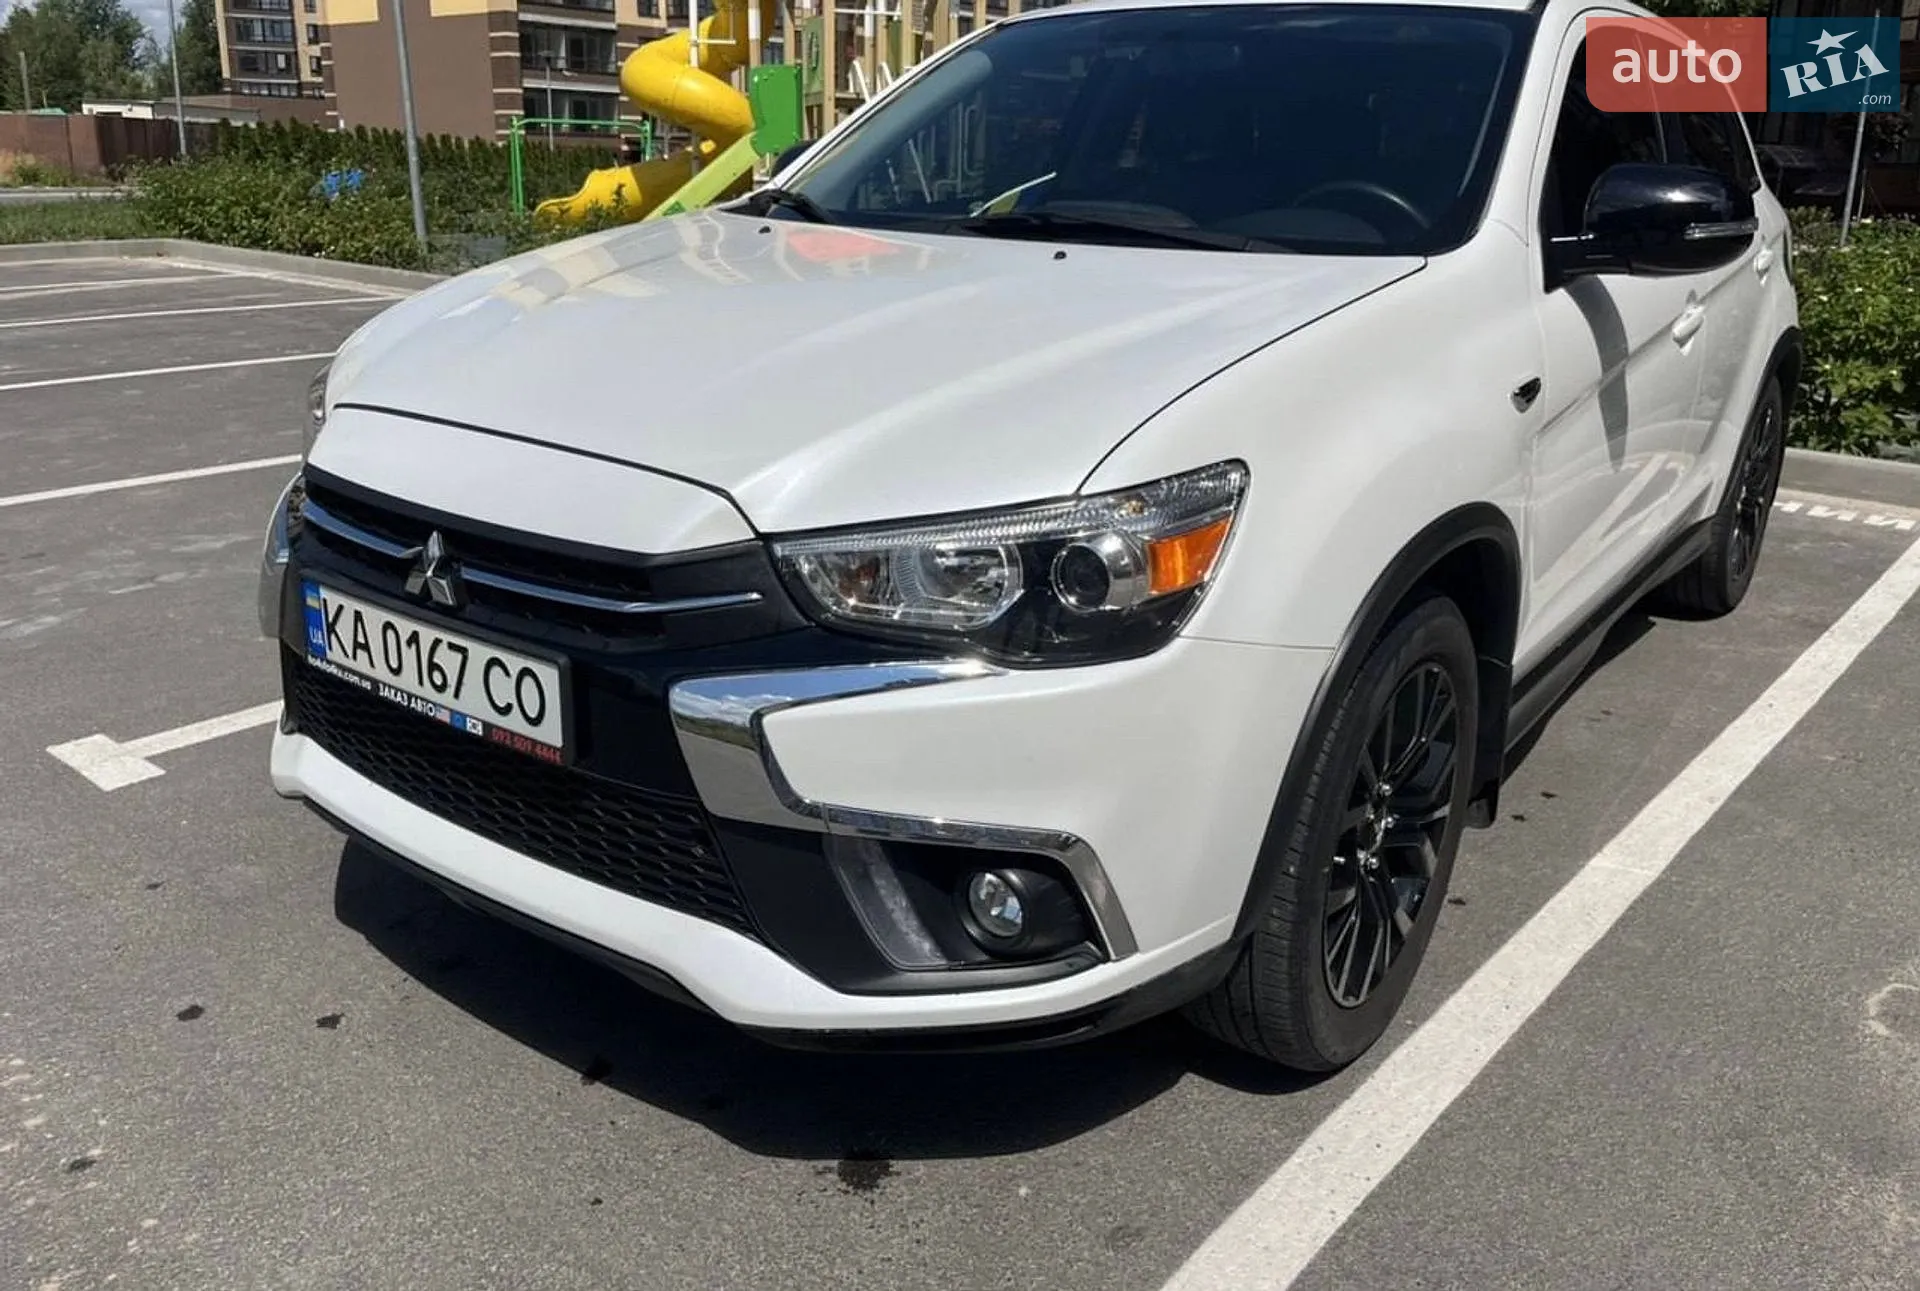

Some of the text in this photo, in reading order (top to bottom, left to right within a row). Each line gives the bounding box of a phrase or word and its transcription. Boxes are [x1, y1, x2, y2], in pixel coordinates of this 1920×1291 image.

[308, 625, 325, 649] UA
[322, 597, 376, 669] KA
[381, 620, 469, 700] 0167
[483, 656, 546, 727] CO
[378, 682, 409, 707] ЗАКАЗ
